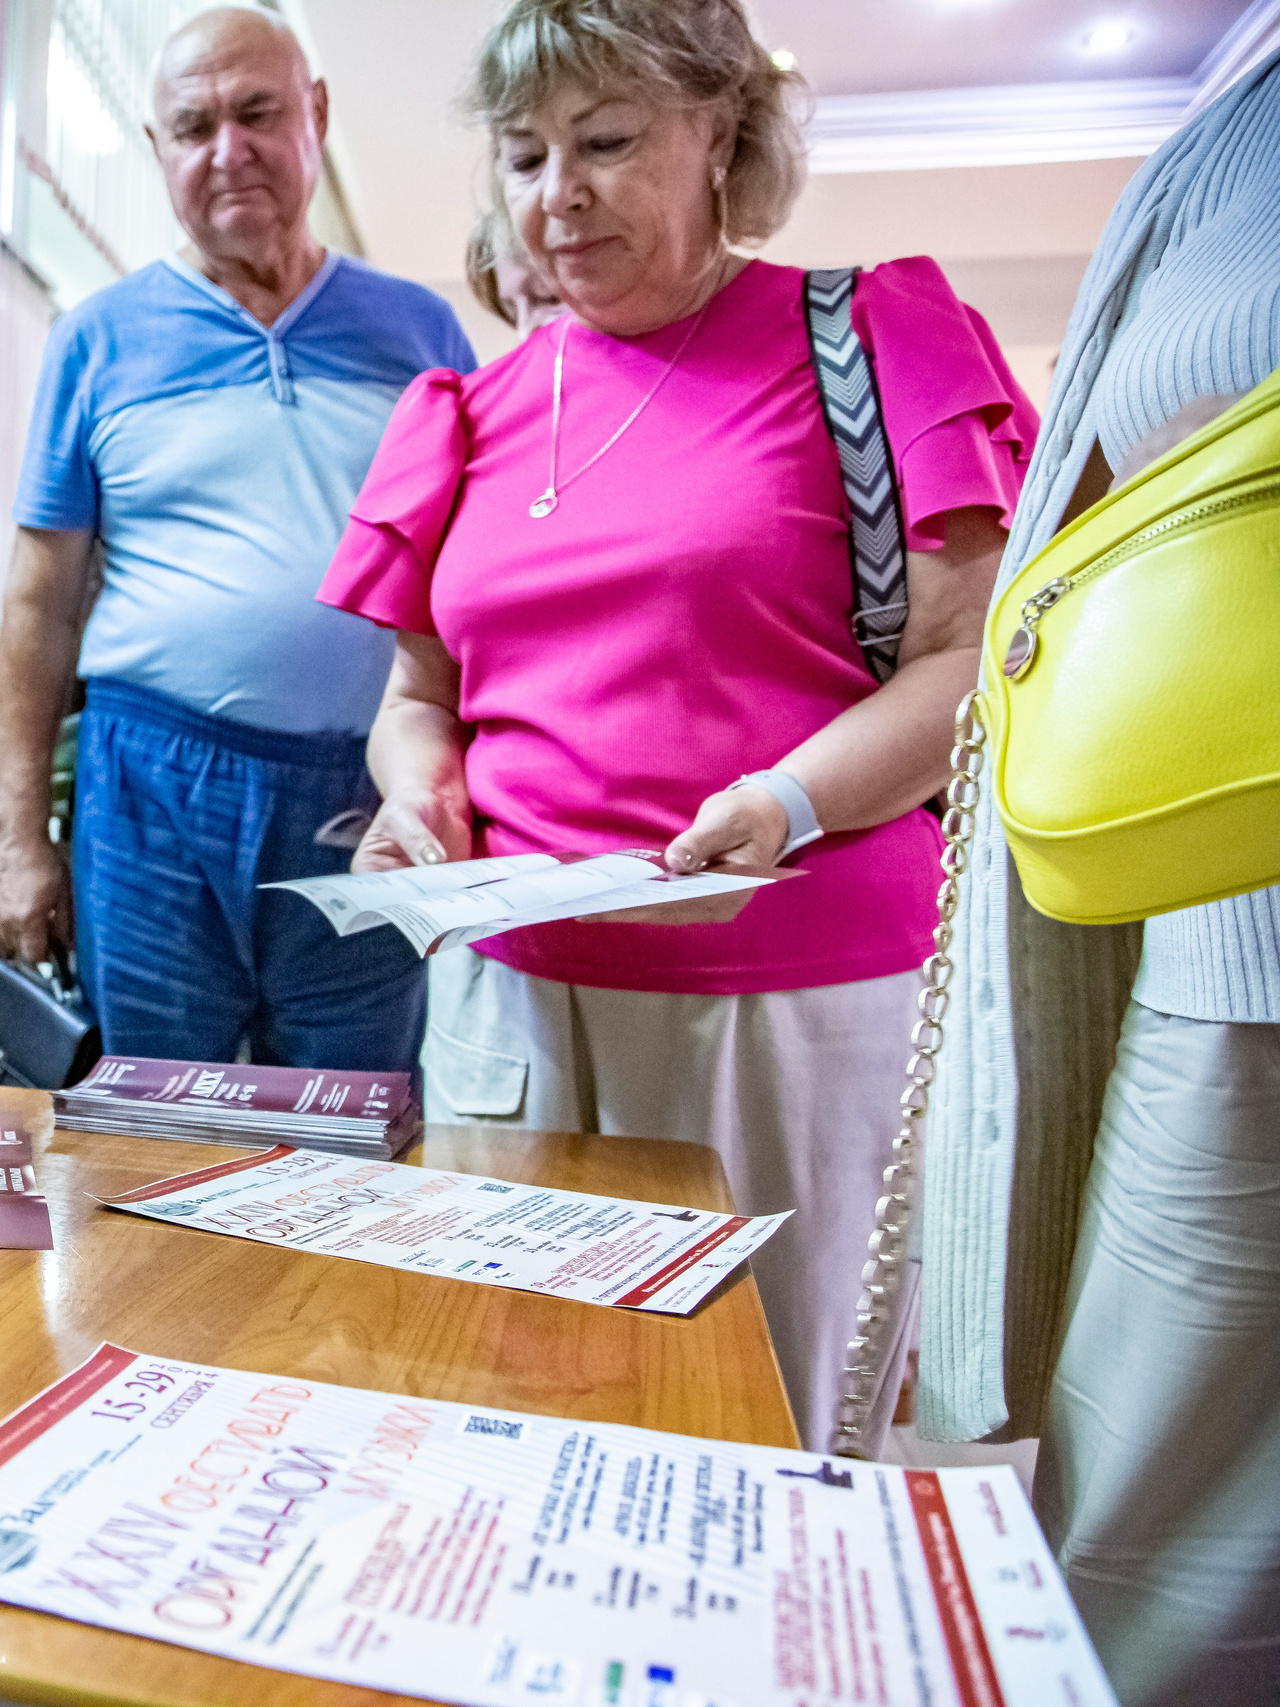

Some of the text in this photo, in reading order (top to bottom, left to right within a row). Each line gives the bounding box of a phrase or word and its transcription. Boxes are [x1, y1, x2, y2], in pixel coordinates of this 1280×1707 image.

[256, 1156, 315, 1176] 15-29
[274, 1164, 396, 1207] ФЕСТИВАЛЬ
[246, 1188, 395, 1239] ОРГАННОЙ
[91, 1370, 176, 1423] 15-29
[150, 1380, 215, 1429] СЕНТЯБРЯ
[340, 1403, 440, 1500] МУЗЫКИ
[37, 1501, 193, 1610] XXIV
[160, 1384, 313, 1513] ФЕСТИВАЛЬ
[151, 1444, 348, 1632] ОРГАННОЙ
